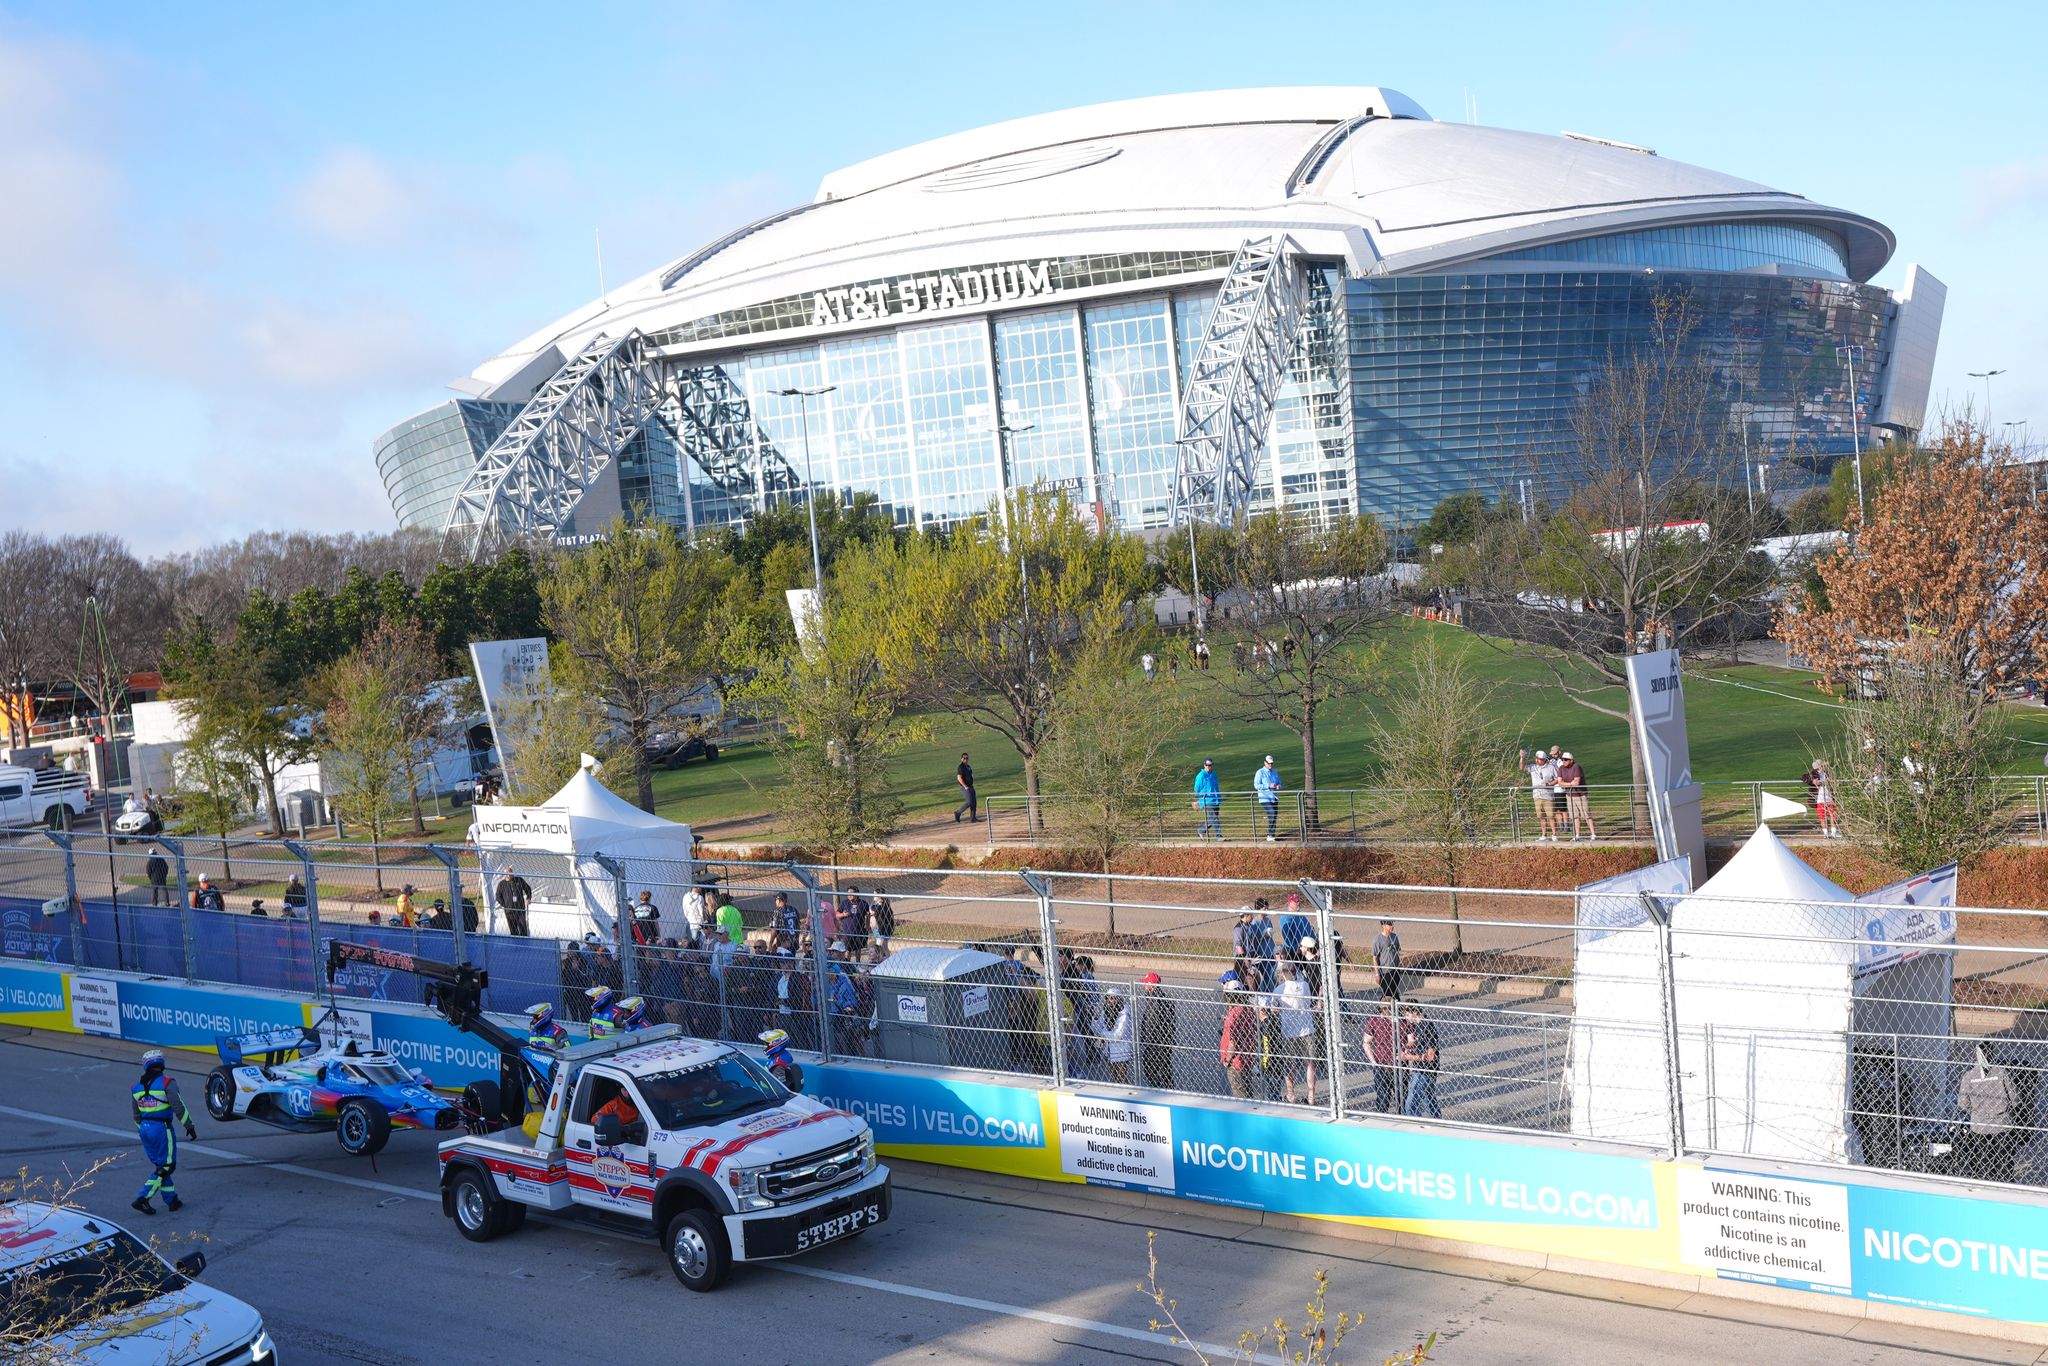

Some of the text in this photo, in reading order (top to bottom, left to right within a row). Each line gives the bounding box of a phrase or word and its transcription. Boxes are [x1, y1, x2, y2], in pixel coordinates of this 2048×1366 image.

[812, 260, 1053, 326] AT&T STADIUM
[556, 536, 577, 546] AT&T
[1650, 675, 1679, 693] SILVER LOTS
[482, 823, 568, 835] INFORMATION
[1906, 913, 1925, 929] ADA
[11, 989, 63, 1009] VELO.COM
[901, 1002, 926, 1012] United
[122, 1003, 297, 1036] NICOTINE POUCHES VELO
[377, 1037, 442, 1063] NICOTINE
[445, 1047, 502, 1072] POUCH
[922, 1109, 1039, 1145] VELO.COM
[1080, 1105, 1147, 1125] WARNING: This
[1062, 1122, 1170, 1145] product contains nicotine.
[1087, 1140, 1145, 1159] Nicotine is an
[597, 1162, 626, 1176] STEPP'S
[1077, 1157, 1159, 1178] addictive chemical.
[1181, 1140, 1650, 1226] NICOTINE POUCHES VELO.COM
[1711, 1181, 1811, 1207] WARNING: This
[797, 1204, 880, 1250] STEPP'S
[1683, 1202, 1845, 1233] product contains nicotine.
[1720, 1224, 1807, 1249] Nicotine is an
[1704, 1245, 1826, 1273] addictive chemical.
[1864, 1227, 2048, 1281] NICOTINE
